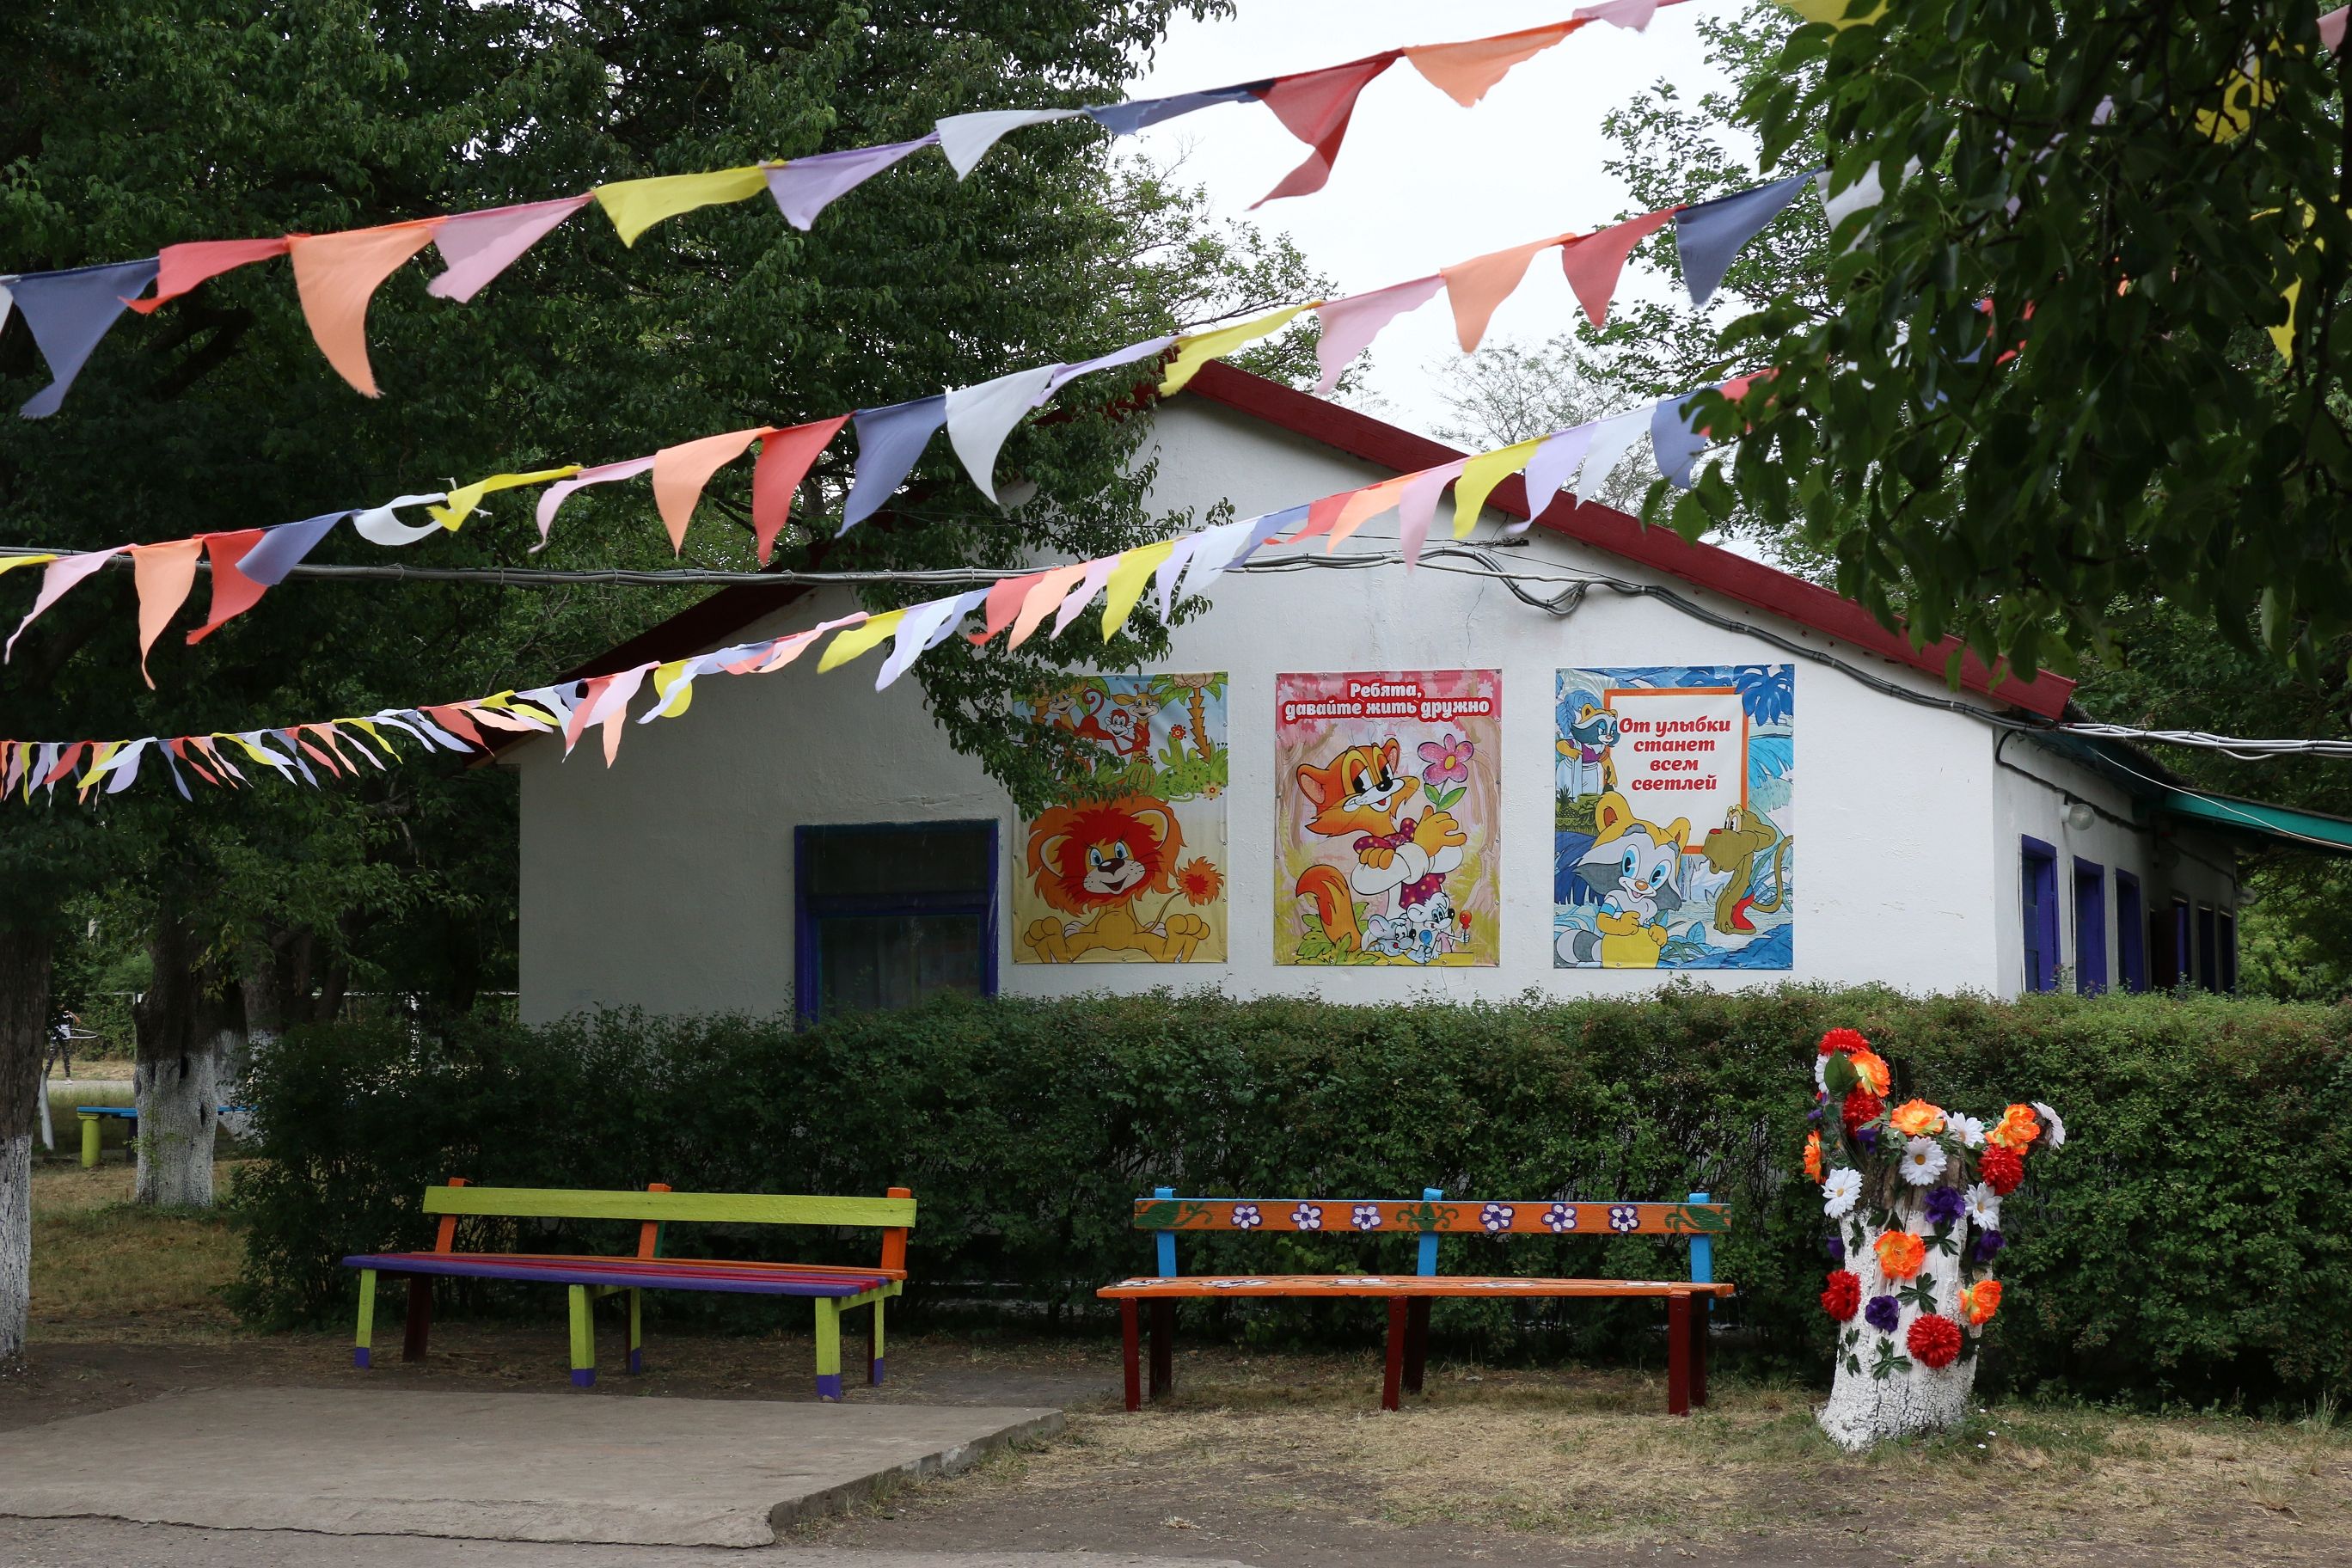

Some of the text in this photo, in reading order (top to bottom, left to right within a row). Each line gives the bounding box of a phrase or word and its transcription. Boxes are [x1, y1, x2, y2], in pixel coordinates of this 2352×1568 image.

[1351, 683, 1422, 698] Ребята,
[1285, 700, 1490, 720] давайте жить дружно
[1619, 715, 1730, 737] От улыбки
[1633, 738, 1716, 752] станет
[1650, 759, 1699, 772] всем
[1632, 775, 1718, 791] светлей
